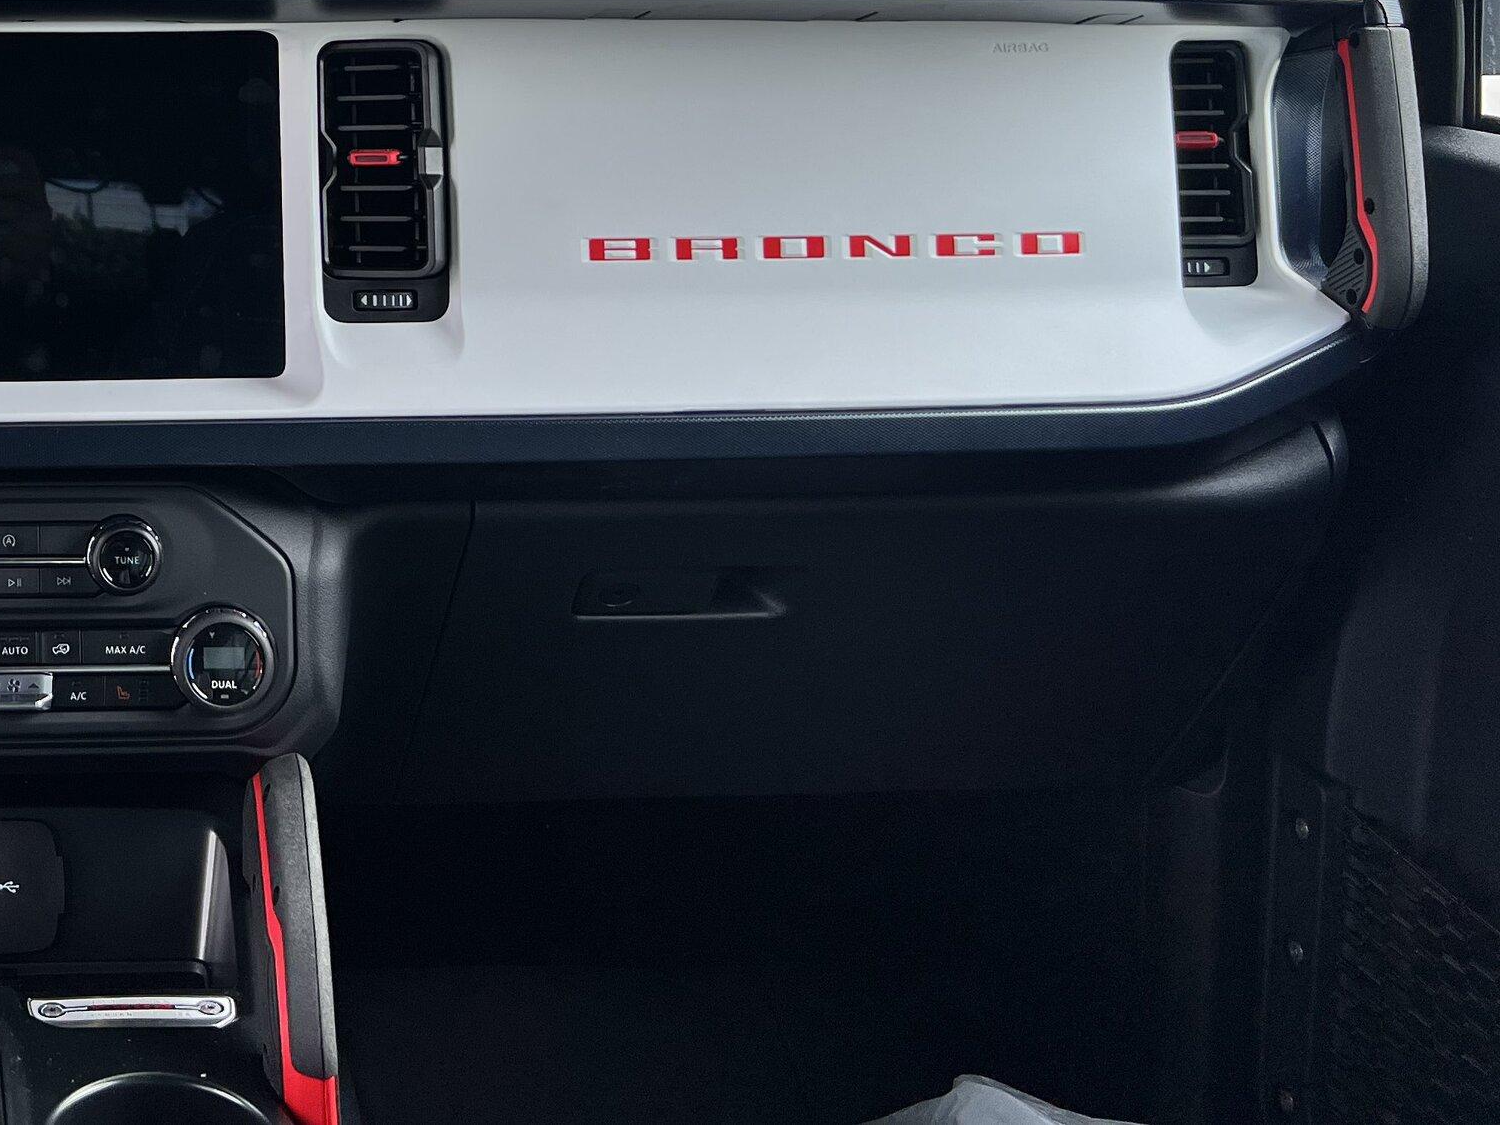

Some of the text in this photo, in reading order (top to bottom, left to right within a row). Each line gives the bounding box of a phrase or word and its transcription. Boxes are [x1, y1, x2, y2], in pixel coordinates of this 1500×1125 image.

[989, 42, 1050, 54] AIRBAG
[584, 231, 1082, 262] BRONCO
[114, 556, 140, 565] TUNE
[1, 646, 28, 656] AUTO
[105, 645, 147, 655] MAX A/C
[211, 680, 238, 690] DUAL
[70, 691, 87, 701] A/C
